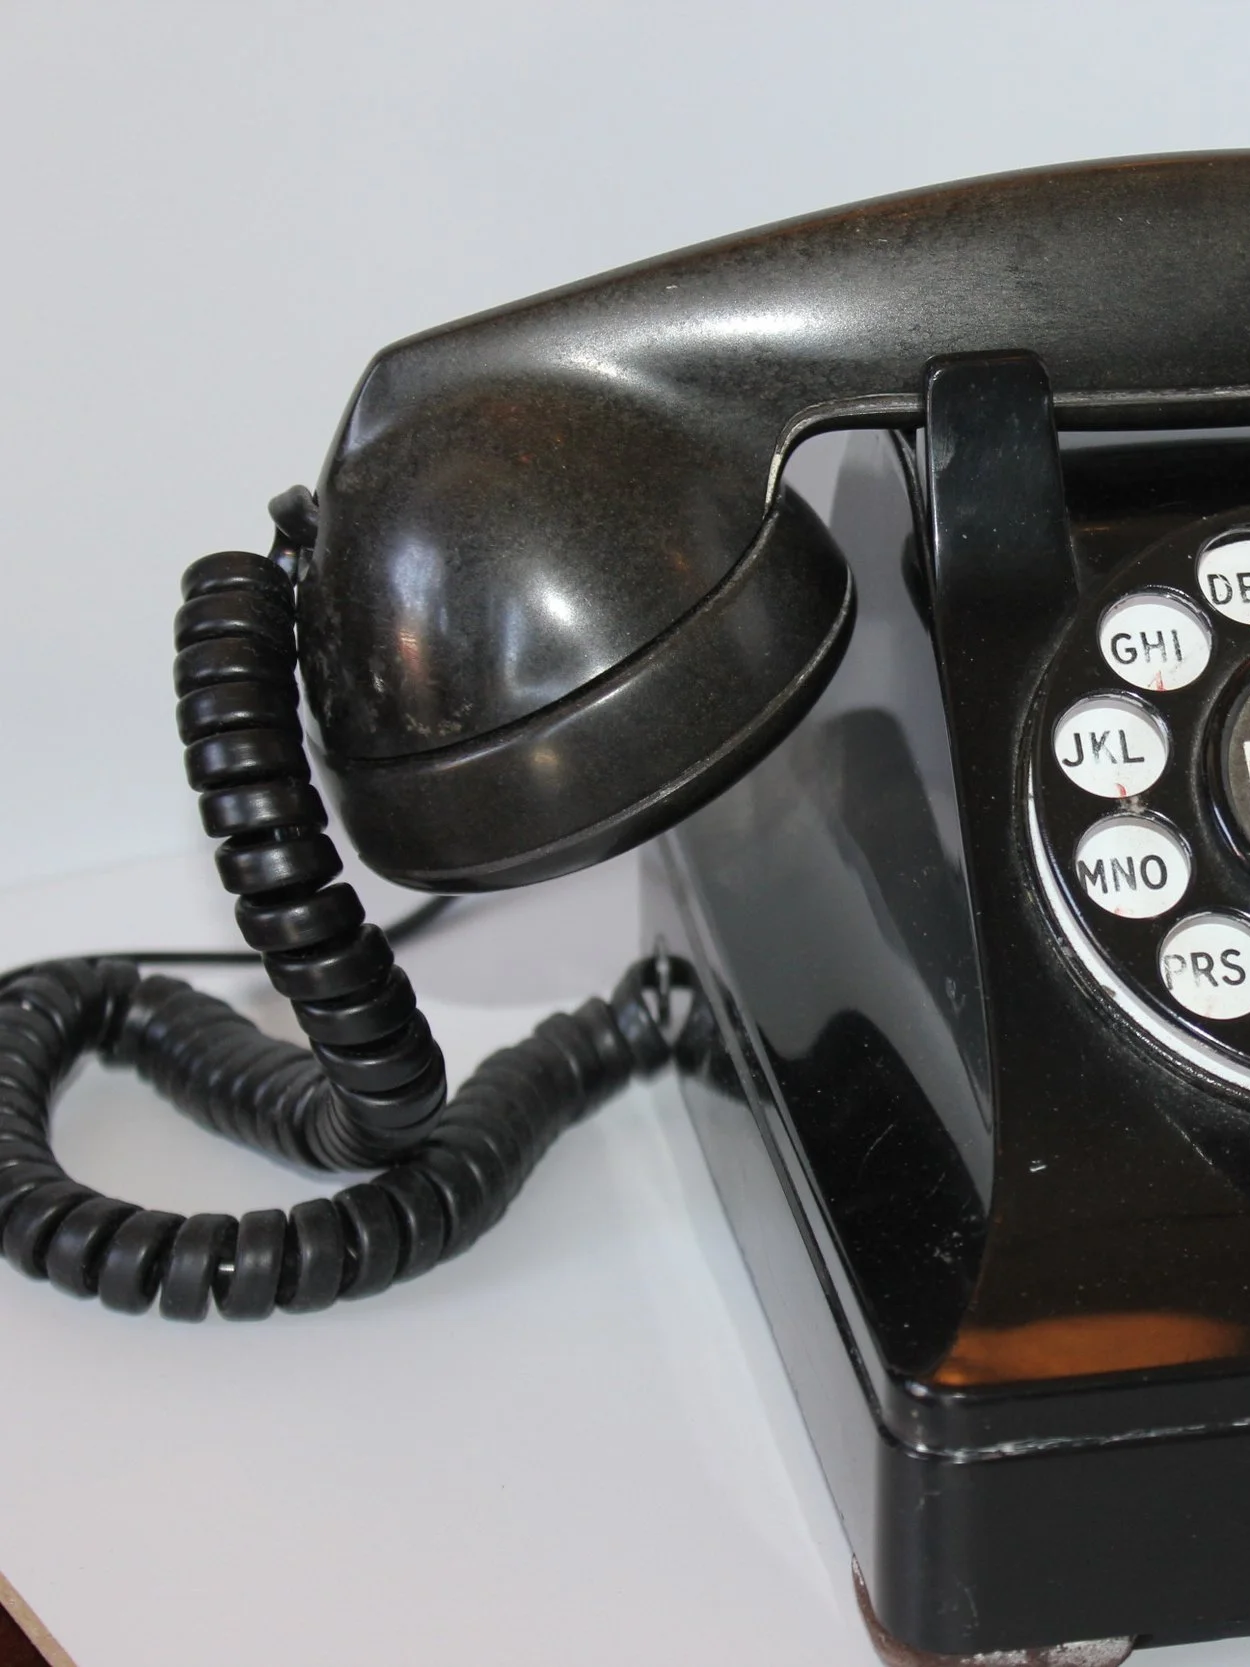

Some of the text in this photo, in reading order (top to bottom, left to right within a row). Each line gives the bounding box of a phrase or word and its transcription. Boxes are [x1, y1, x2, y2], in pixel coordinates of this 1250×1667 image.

[1110, 629, 1183, 665] GHI
[1061, 729, 1146, 768] JKL
[1077, 854, 1169, 895] MNO
[1163, 949, 1247, 990] PRS
